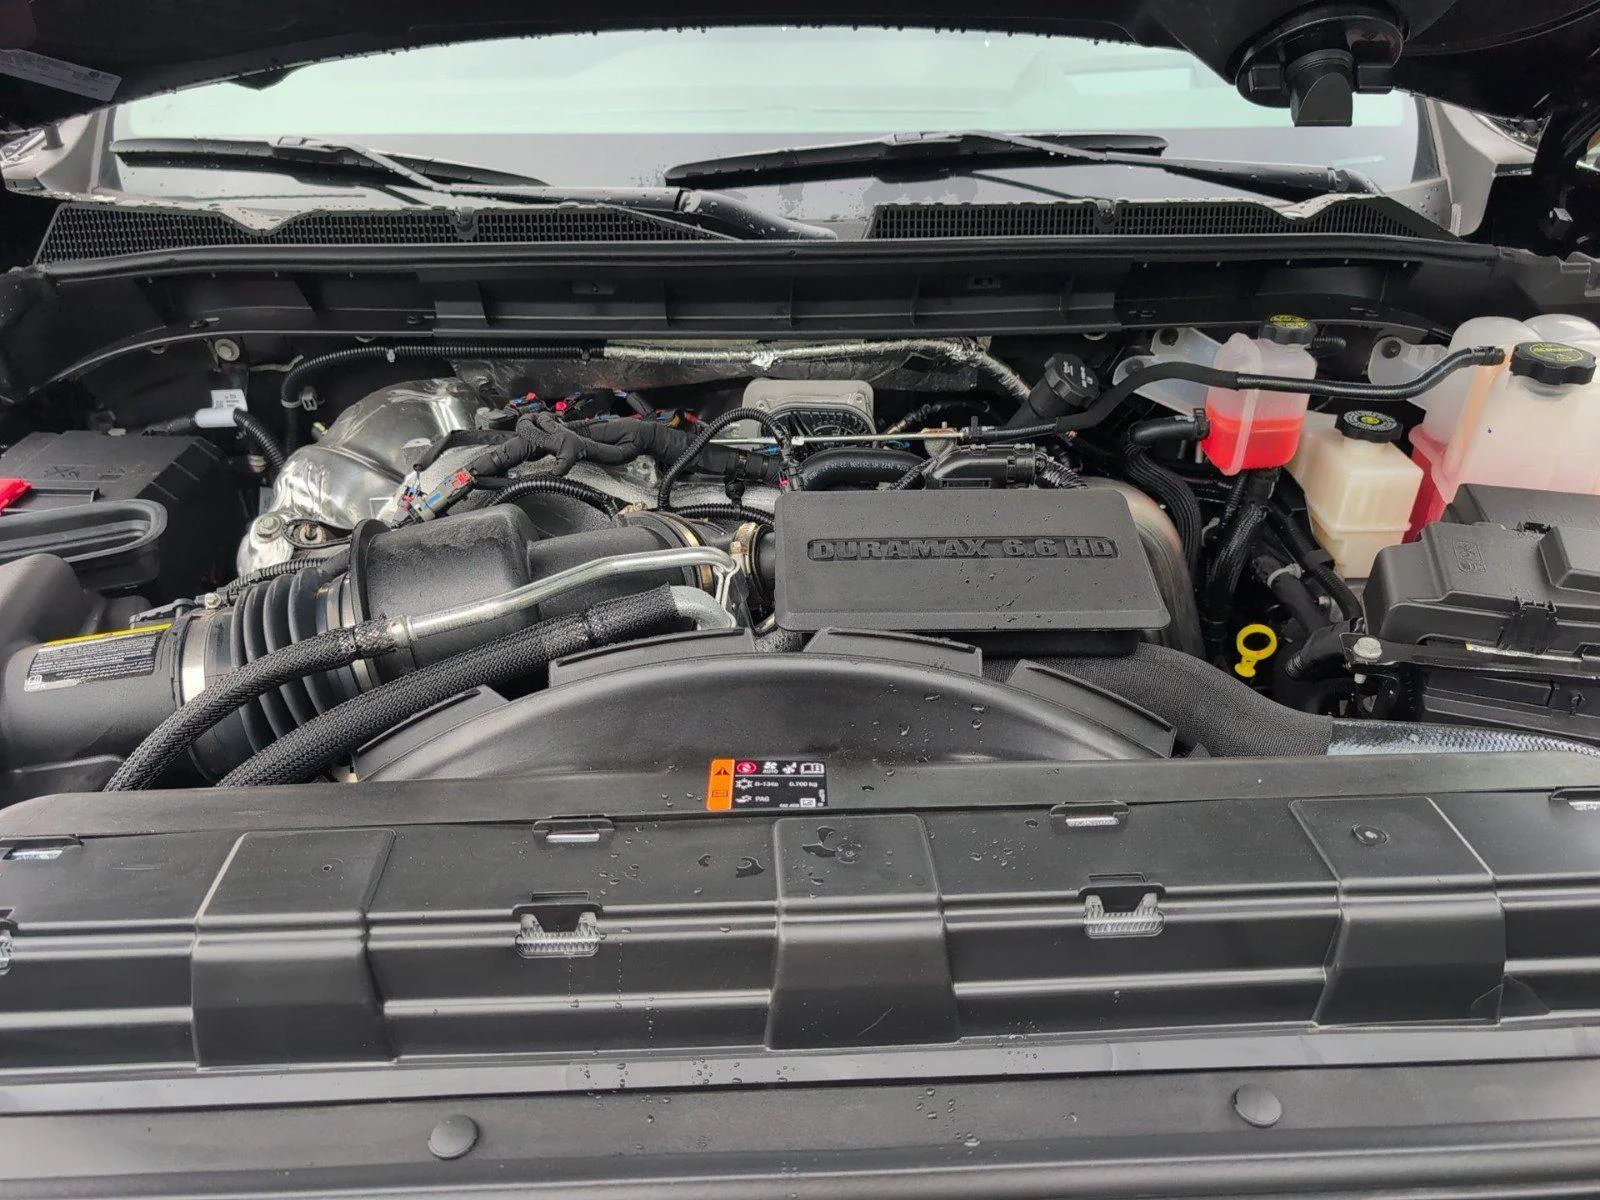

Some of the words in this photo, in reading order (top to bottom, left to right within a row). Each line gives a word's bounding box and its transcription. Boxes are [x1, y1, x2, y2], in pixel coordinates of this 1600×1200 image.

[812, 539, 990, 559] DURAMAX
[1002, 538, 1058, 557] 6.6
[1064, 539, 1115, 557] HD
